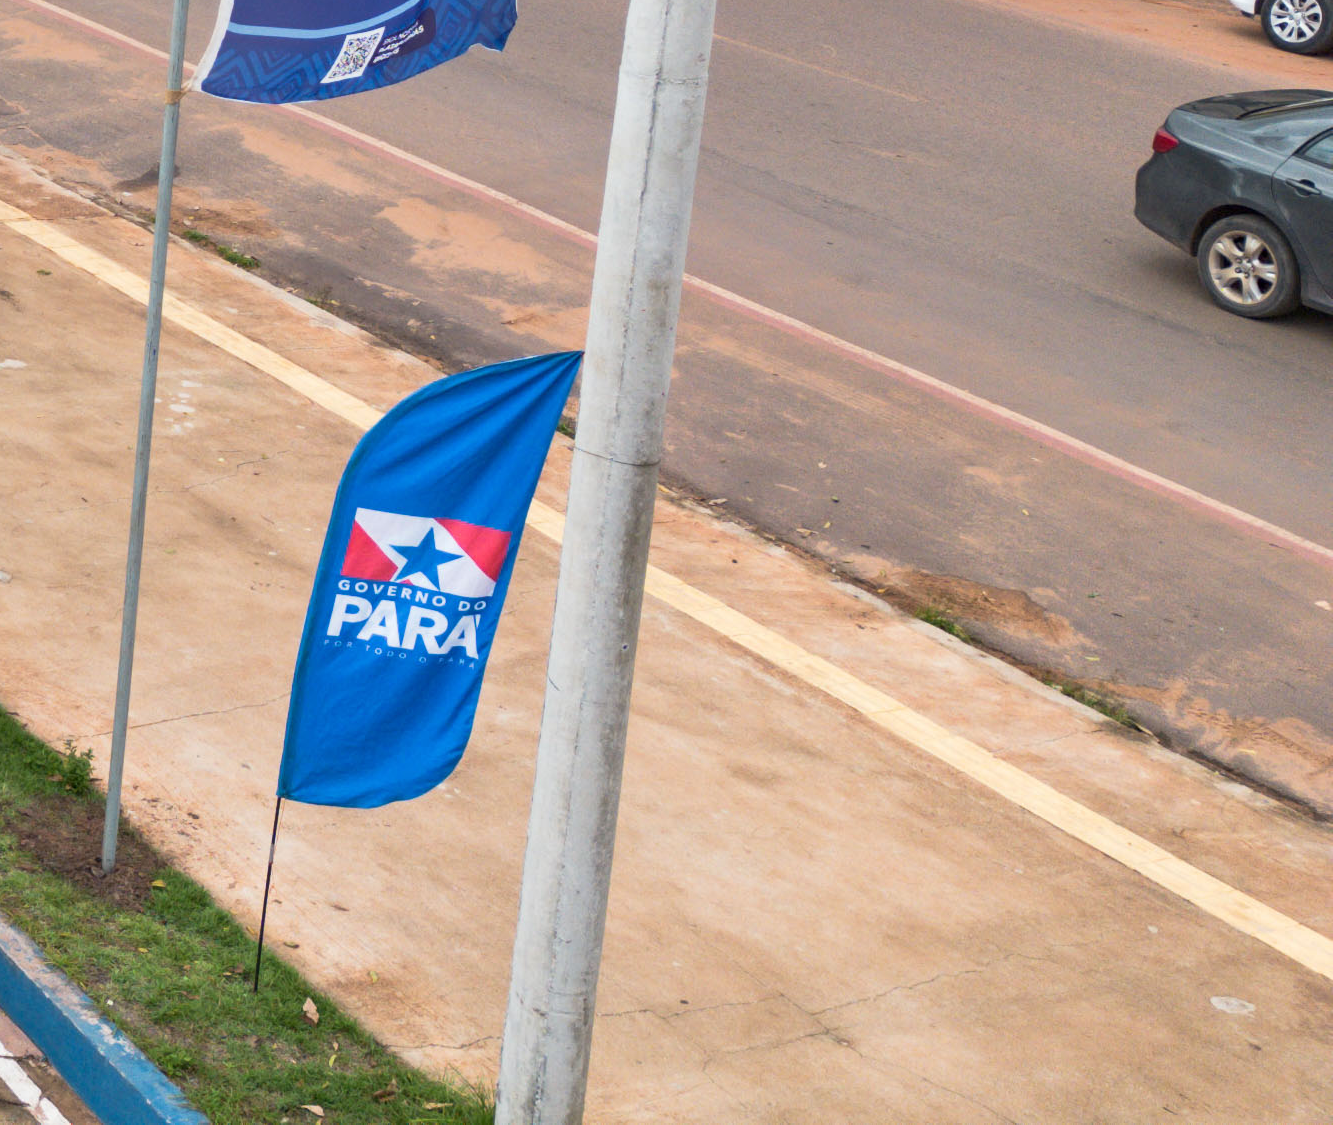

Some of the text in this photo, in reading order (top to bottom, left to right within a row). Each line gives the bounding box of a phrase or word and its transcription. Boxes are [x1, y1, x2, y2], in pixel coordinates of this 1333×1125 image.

[337, 579, 486, 613] GOVERNO DO
[365, 645, 407, 659] TODO
[418, 656, 427, 664] O
